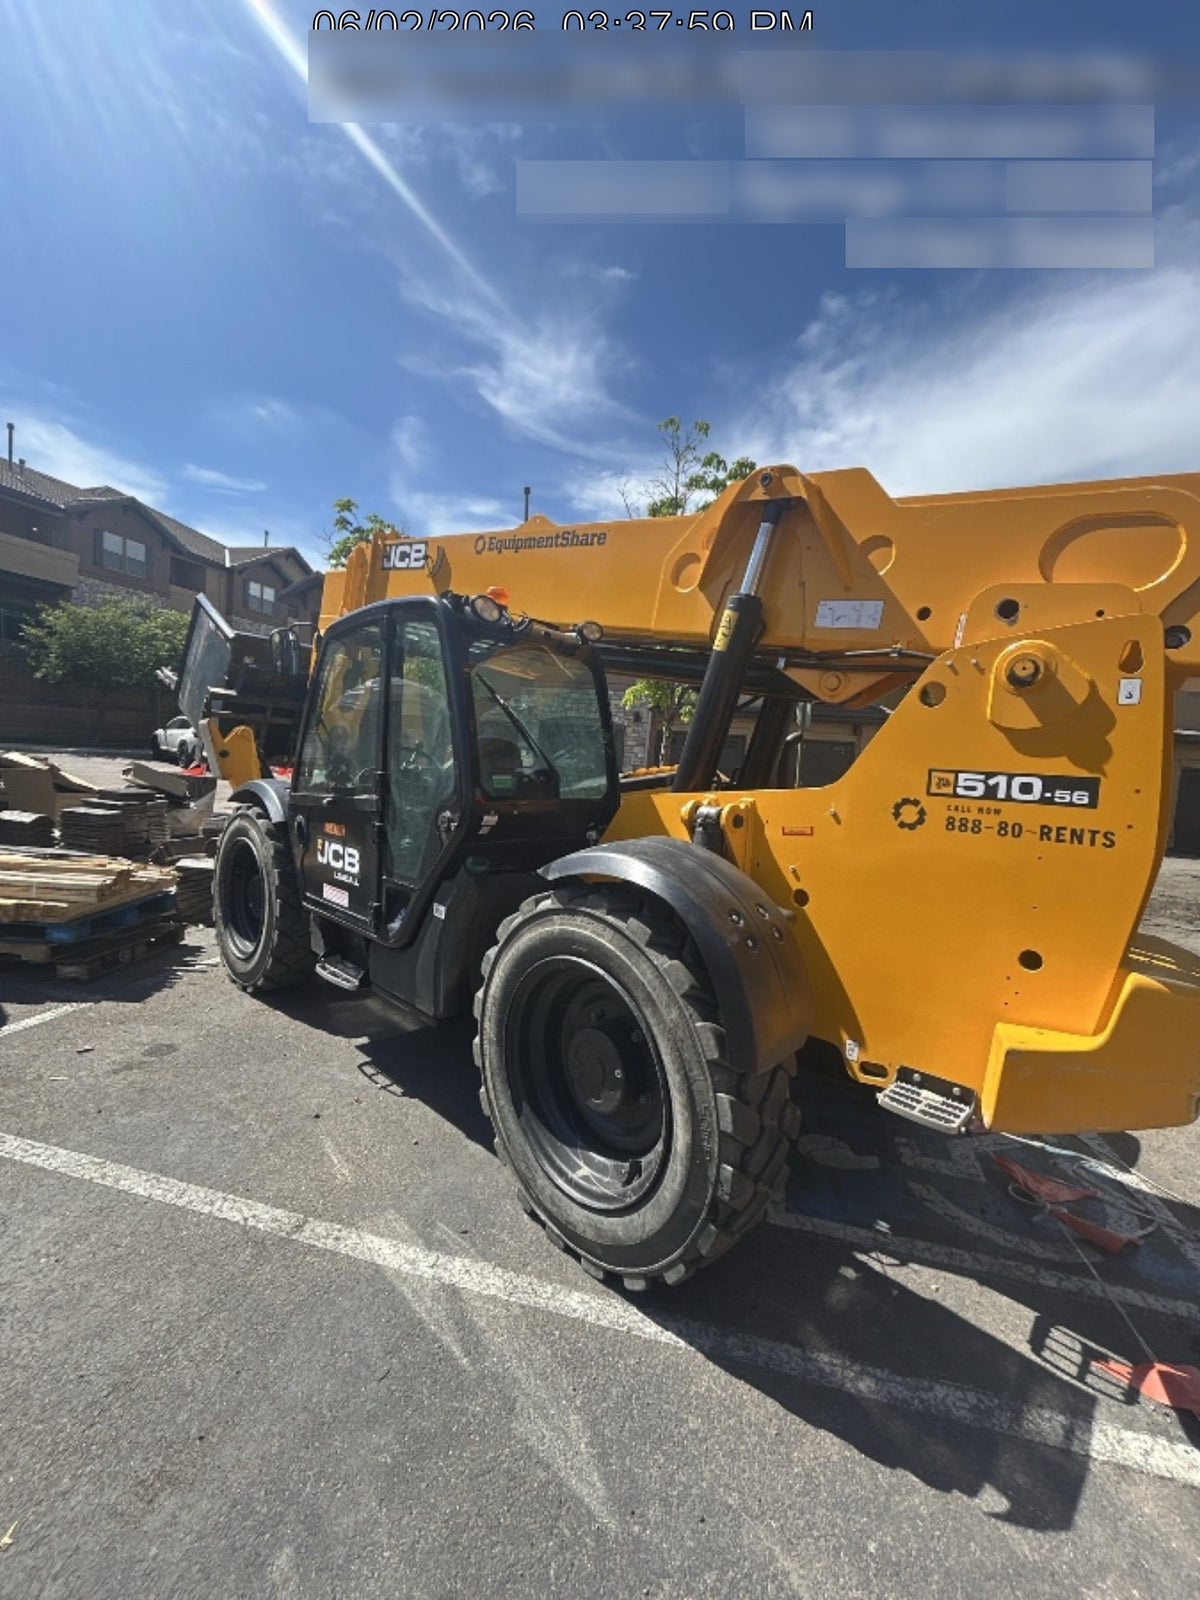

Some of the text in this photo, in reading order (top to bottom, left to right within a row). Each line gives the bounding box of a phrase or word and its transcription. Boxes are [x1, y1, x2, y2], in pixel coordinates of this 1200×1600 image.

[487, 529, 607, 553] EquipmentShare
[383, 543, 426, 568] JCB
[955, 772, 1090, 804] 510-56
[946, 804, 1002, 816] CALL NOW
[945, 815, 1116, 849] 888-80-RENTS
[317, 839, 360, 874] JCB
